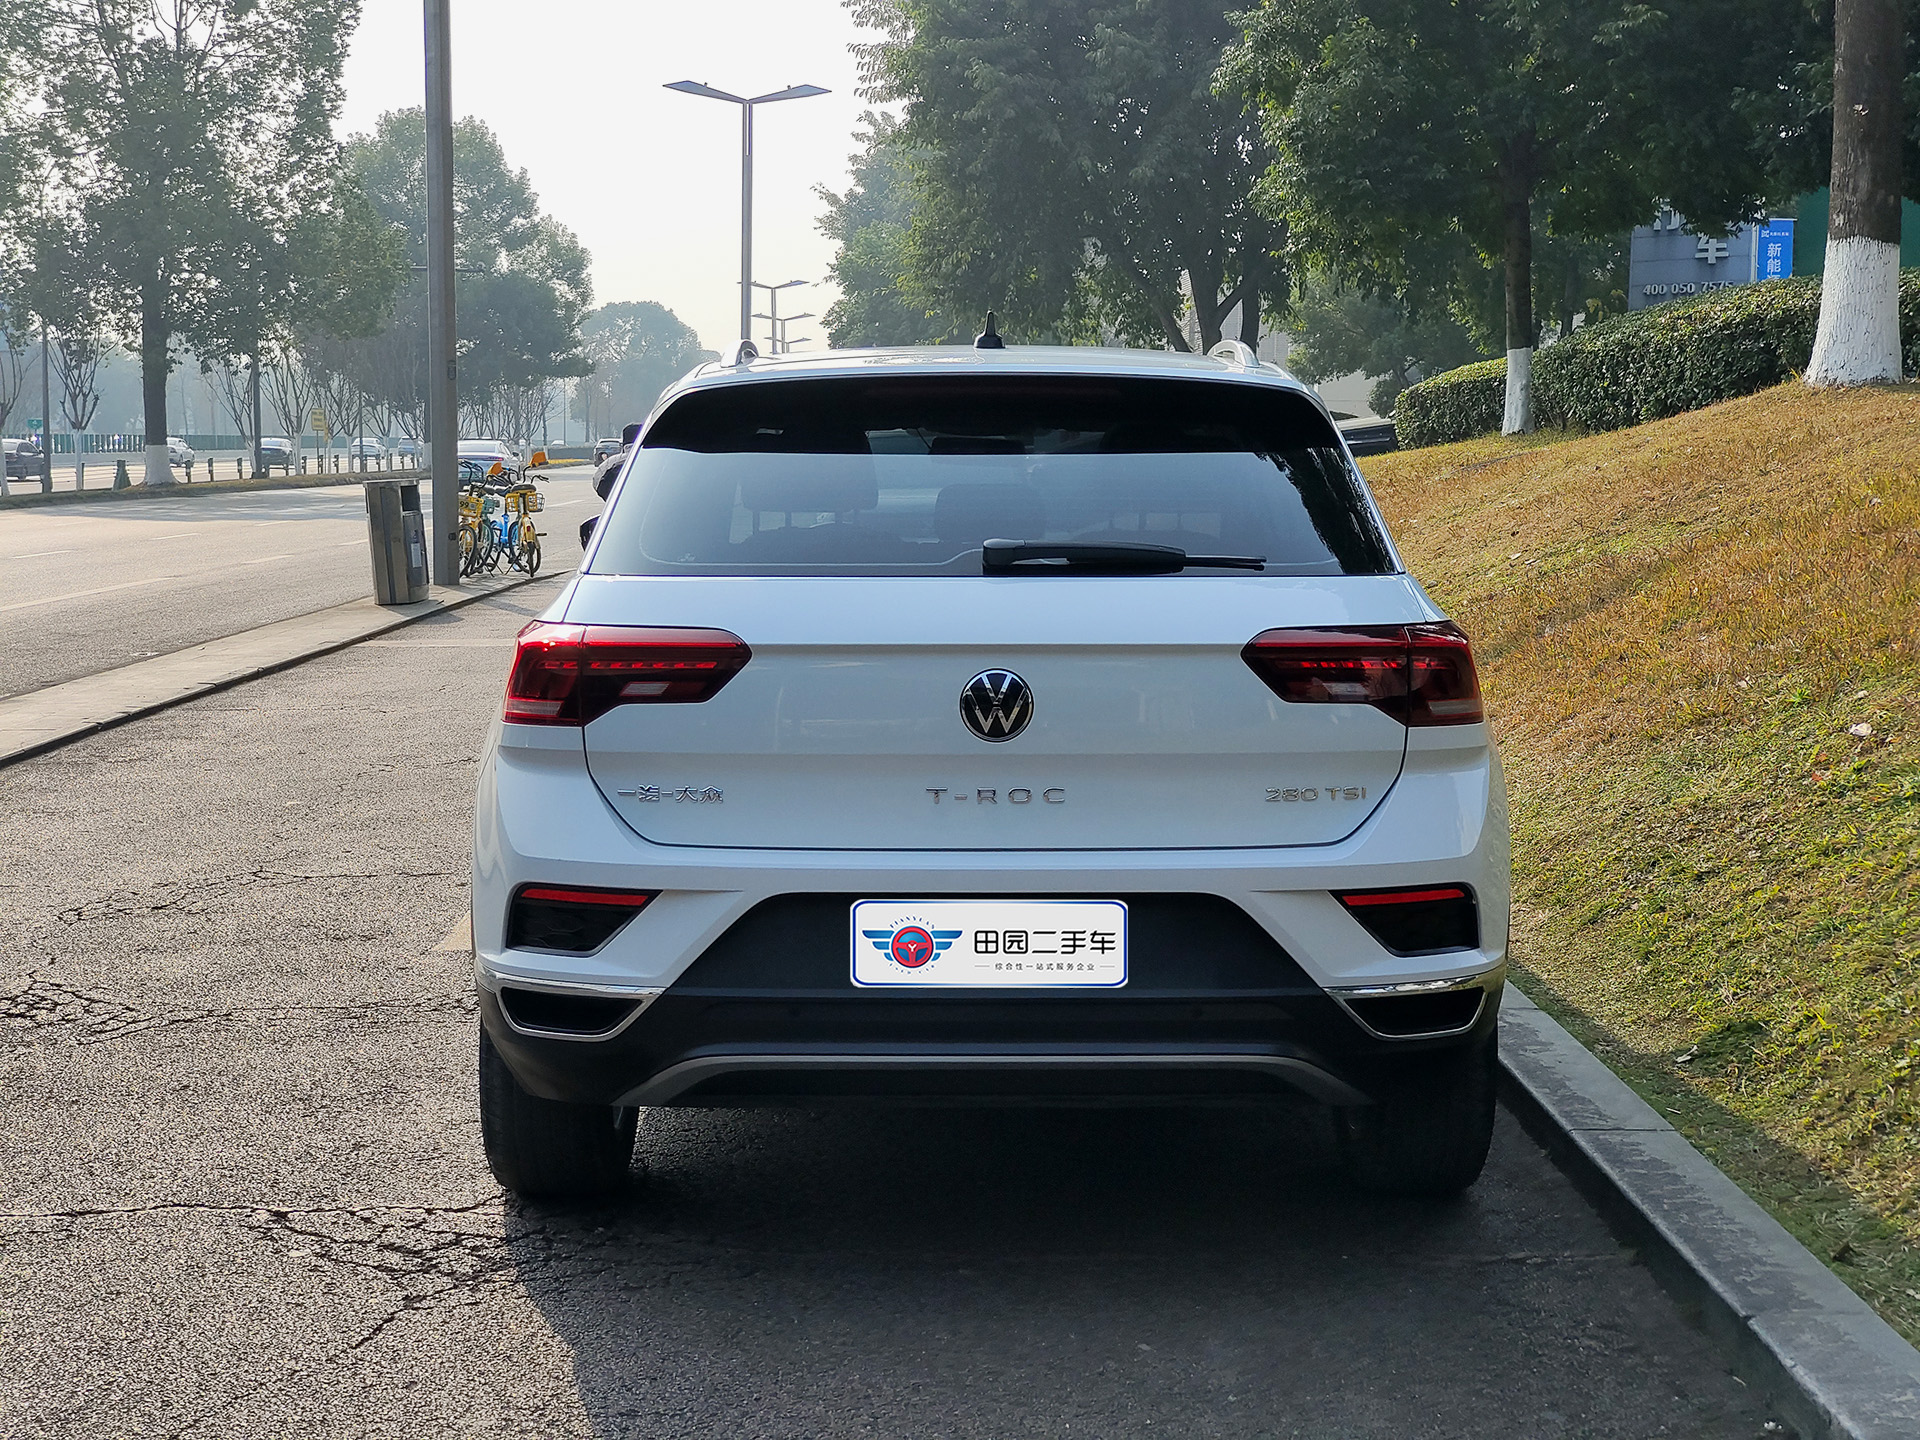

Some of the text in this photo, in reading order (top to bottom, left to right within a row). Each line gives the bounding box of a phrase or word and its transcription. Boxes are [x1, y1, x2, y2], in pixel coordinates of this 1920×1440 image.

[1642, 283, 1668, 296] 400
[1670, 282, 1696, 295] 050
[925, 785, 1066, 805] T-ROC
[1264, 785, 1368, 802] 280 TSI
[973, 929, 1117, 955] 田园二手车
[994, 962, 1096, 971] 综合性一站式服务企业
